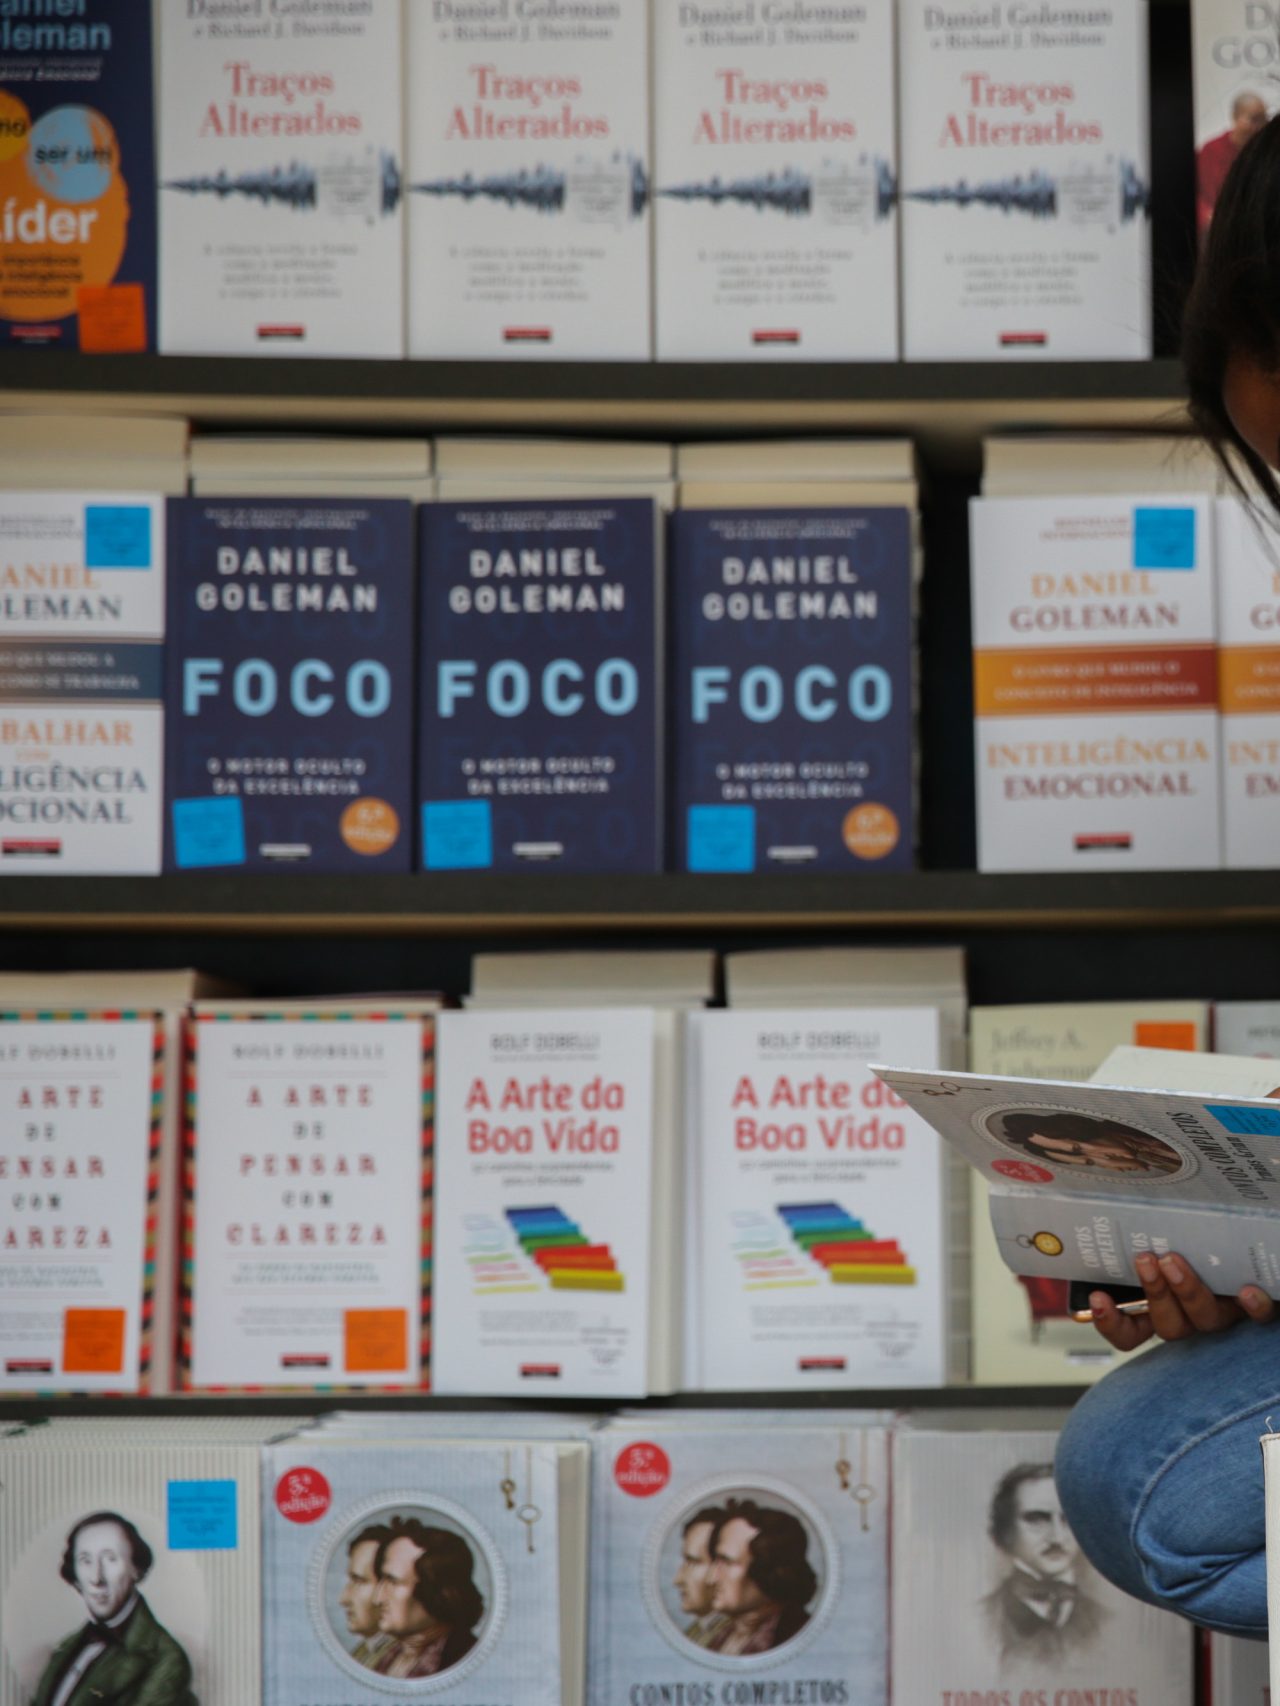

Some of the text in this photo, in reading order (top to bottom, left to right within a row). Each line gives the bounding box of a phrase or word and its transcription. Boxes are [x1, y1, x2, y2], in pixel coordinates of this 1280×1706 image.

[224, 60, 334, 103] Traços
[468, 63, 582, 106] Traços
[715, 68, 828, 112] Traços
[962, 70, 1075, 115] Traços
[200, 102, 361, 138] Alterados
[445, 105, 609, 140] Alterados
[692, 107, 857, 145] Alterados
[939, 110, 1103, 149] Alterados
[34, 144, 68, 164] ser
[0, 196, 99, 244] íder
[217, 546, 358, 577] DANIEL
[469, 547, 606, 579] DANIEL
[722, 556, 859, 586] DANIEL
[195, 582, 378, 612] GOLEMAN
[448, 582, 627, 615] GOLEMAN
[1031, 570, 1158, 599] DANIEL
[0, 593, 122, 621] LEMAN
[702, 591, 878, 622] GOLEMAN
[1009, 602, 1180, 633] GOLEMAN
[182, 657, 393, 718] FOCO
[437, 656, 639, 719] FOCO
[691, 664, 893, 724] FOCO
[986, 730, 1210, 769] INTELIGÊNCIA
[1003, 771, 1198, 801] EMOCIONAL
[17, 1086, 105, 1110] ARTE
[247, 1085, 374, 1108] A ARTE
[464, 1074, 625, 1112] A Arte da
[730, 1074, 760, 1110] A
[768, 1072, 852, 1111] Arte
[26, 1122, 56, 1142] DE
[294, 1121, 325, 1141] DE
[467, 1116, 621, 1154] Boa Vida
[735, 1114, 906, 1152] Boa Vida
[239, 1153, 379, 1178] PENSAR
[1166, 1110, 1270, 1201] CONTOS COMPLETOS
[13, 1192, 63, 1212] COM
[283, 1191, 334, 1209] COM
[226, 1222, 388, 1247] CLAREZA
[1074, 1225, 1100, 1269] CONTOS
[1092, 1215, 1124, 1279] COMPLETOS
[629, 1679, 850, 1706] CONTOS COMPLETOS
